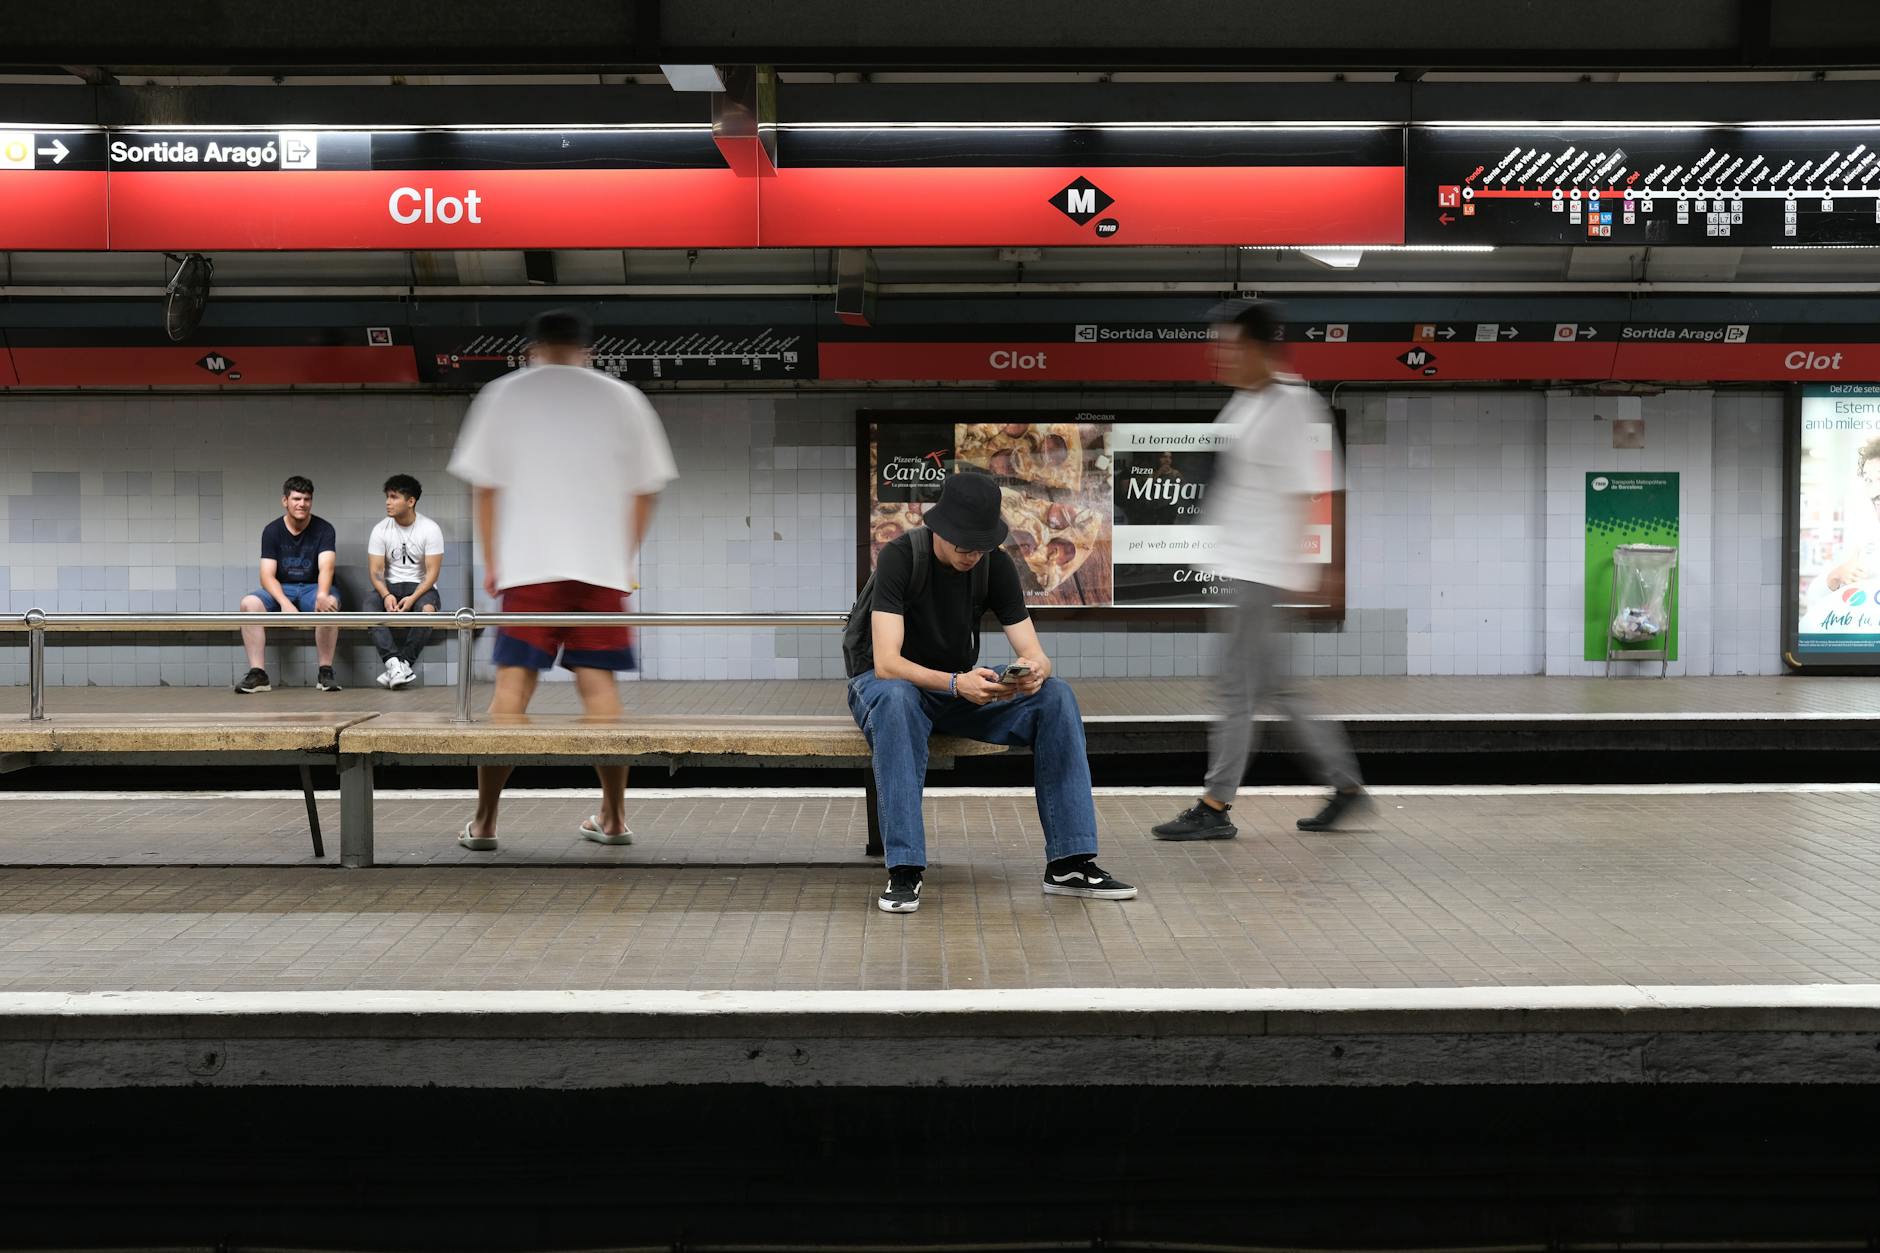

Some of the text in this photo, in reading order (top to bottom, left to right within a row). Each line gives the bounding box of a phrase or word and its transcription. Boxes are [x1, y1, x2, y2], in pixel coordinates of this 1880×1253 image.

[110, 140, 278, 167] Sortida Aragó
[1483, 147, 1521, 184] Santa Coloma
[1501, 169, 1516, 184] Baró
[1515, 163, 1523, 171] de
[1555, 151, 1589, 184] Sant Andreu
[1589, 152, 1622, 184] La Sagrera
[1681, 147, 1716, 185] Arc de Triomf
[1697, 153, 1731, 185] Urquinaona
[1715, 157, 1744, 185] Catalunya
[1733, 154, 1765, 184] Universitat
[1769, 160, 1795, 184] Rocafort
[1788, 160, 1813, 184] Espanya
[1806, 152, 1840, 184] Hostafrancs
[1840, 160, 1849, 169] de
[1843, 164, 1864, 184] Mercat
[1466, 166, 1484, 183] Fondo
[1573, 168, 1590, 184] Fabra
[1607, 166, 1627, 185] Navas
[1626, 171, 1641, 184] Clot
[1661, 164, 1684, 185] Marina
[1751, 166, 1771, 185] Urgell
[388, 186, 482, 225] Clot
[1067, 188, 1096, 213] M
[1440, 192, 1455, 206] L1
[1100, 327, 1219, 340] Sortida València
[1422, 327, 1435, 338] R
[1622, 326, 1724, 342] Sortida Aragó
[206, 357, 226, 370] M
[989, 350, 1047, 370] Clot
[1407, 352, 1425, 365] M
[1784, 351, 1843, 370] Clot
[1830, 385, 1842, 393] Del
[1843, 385, 1853, 393] 27
[1853, 385, 1863, 393] de
[1835, 401, 1874, 414] Estem
[1806, 418, 1833, 430] amb
[1836, 418, 1873, 430] milers
[1131, 434, 1145, 445] La
[1149, 434, 1195, 445] tornada
[1198, 434, 1210, 444] és
[883, 462, 946, 481] Carlos
[1131, 466, 1154, 475] Pizza
[1187, 505, 1203, 514] do
[1129, 541, 1143, 551] pel
[1147, 540, 1167, 549] web
[1169, 540, 1189, 549] amb
[1191, 540, 1200, 549] el
[1173, 569, 1192, 582] C/
[1194, 570, 1215, 582] del
[1208, 586, 1218, 594] 10
[1820, 610, 1853, 630] Amb
